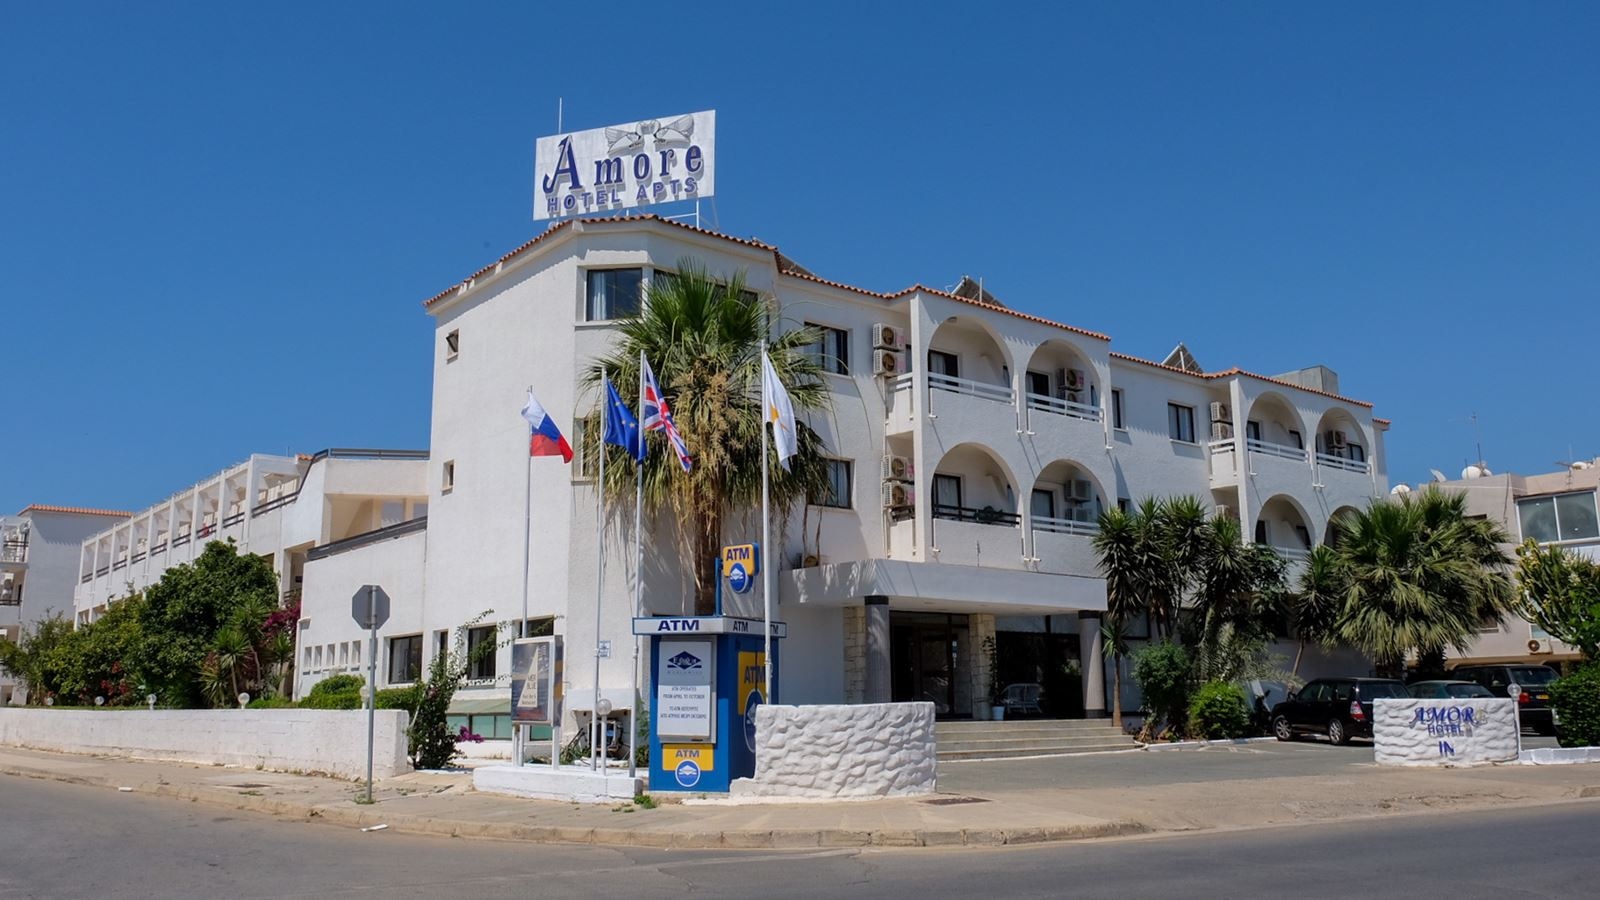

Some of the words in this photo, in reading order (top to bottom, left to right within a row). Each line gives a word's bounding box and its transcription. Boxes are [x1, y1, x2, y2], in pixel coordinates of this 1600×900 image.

[542, 135, 703, 194] Amore
[547, 188, 621, 212] HOTEL
[636, 177, 699, 200] APTS
[725, 547, 750, 562] ATM
[657, 619, 700, 631] ATM
[732, 620, 749, 633] ATM
[675, 749, 700, 758] ATM
[1438, 740, 1455, 757] IN
